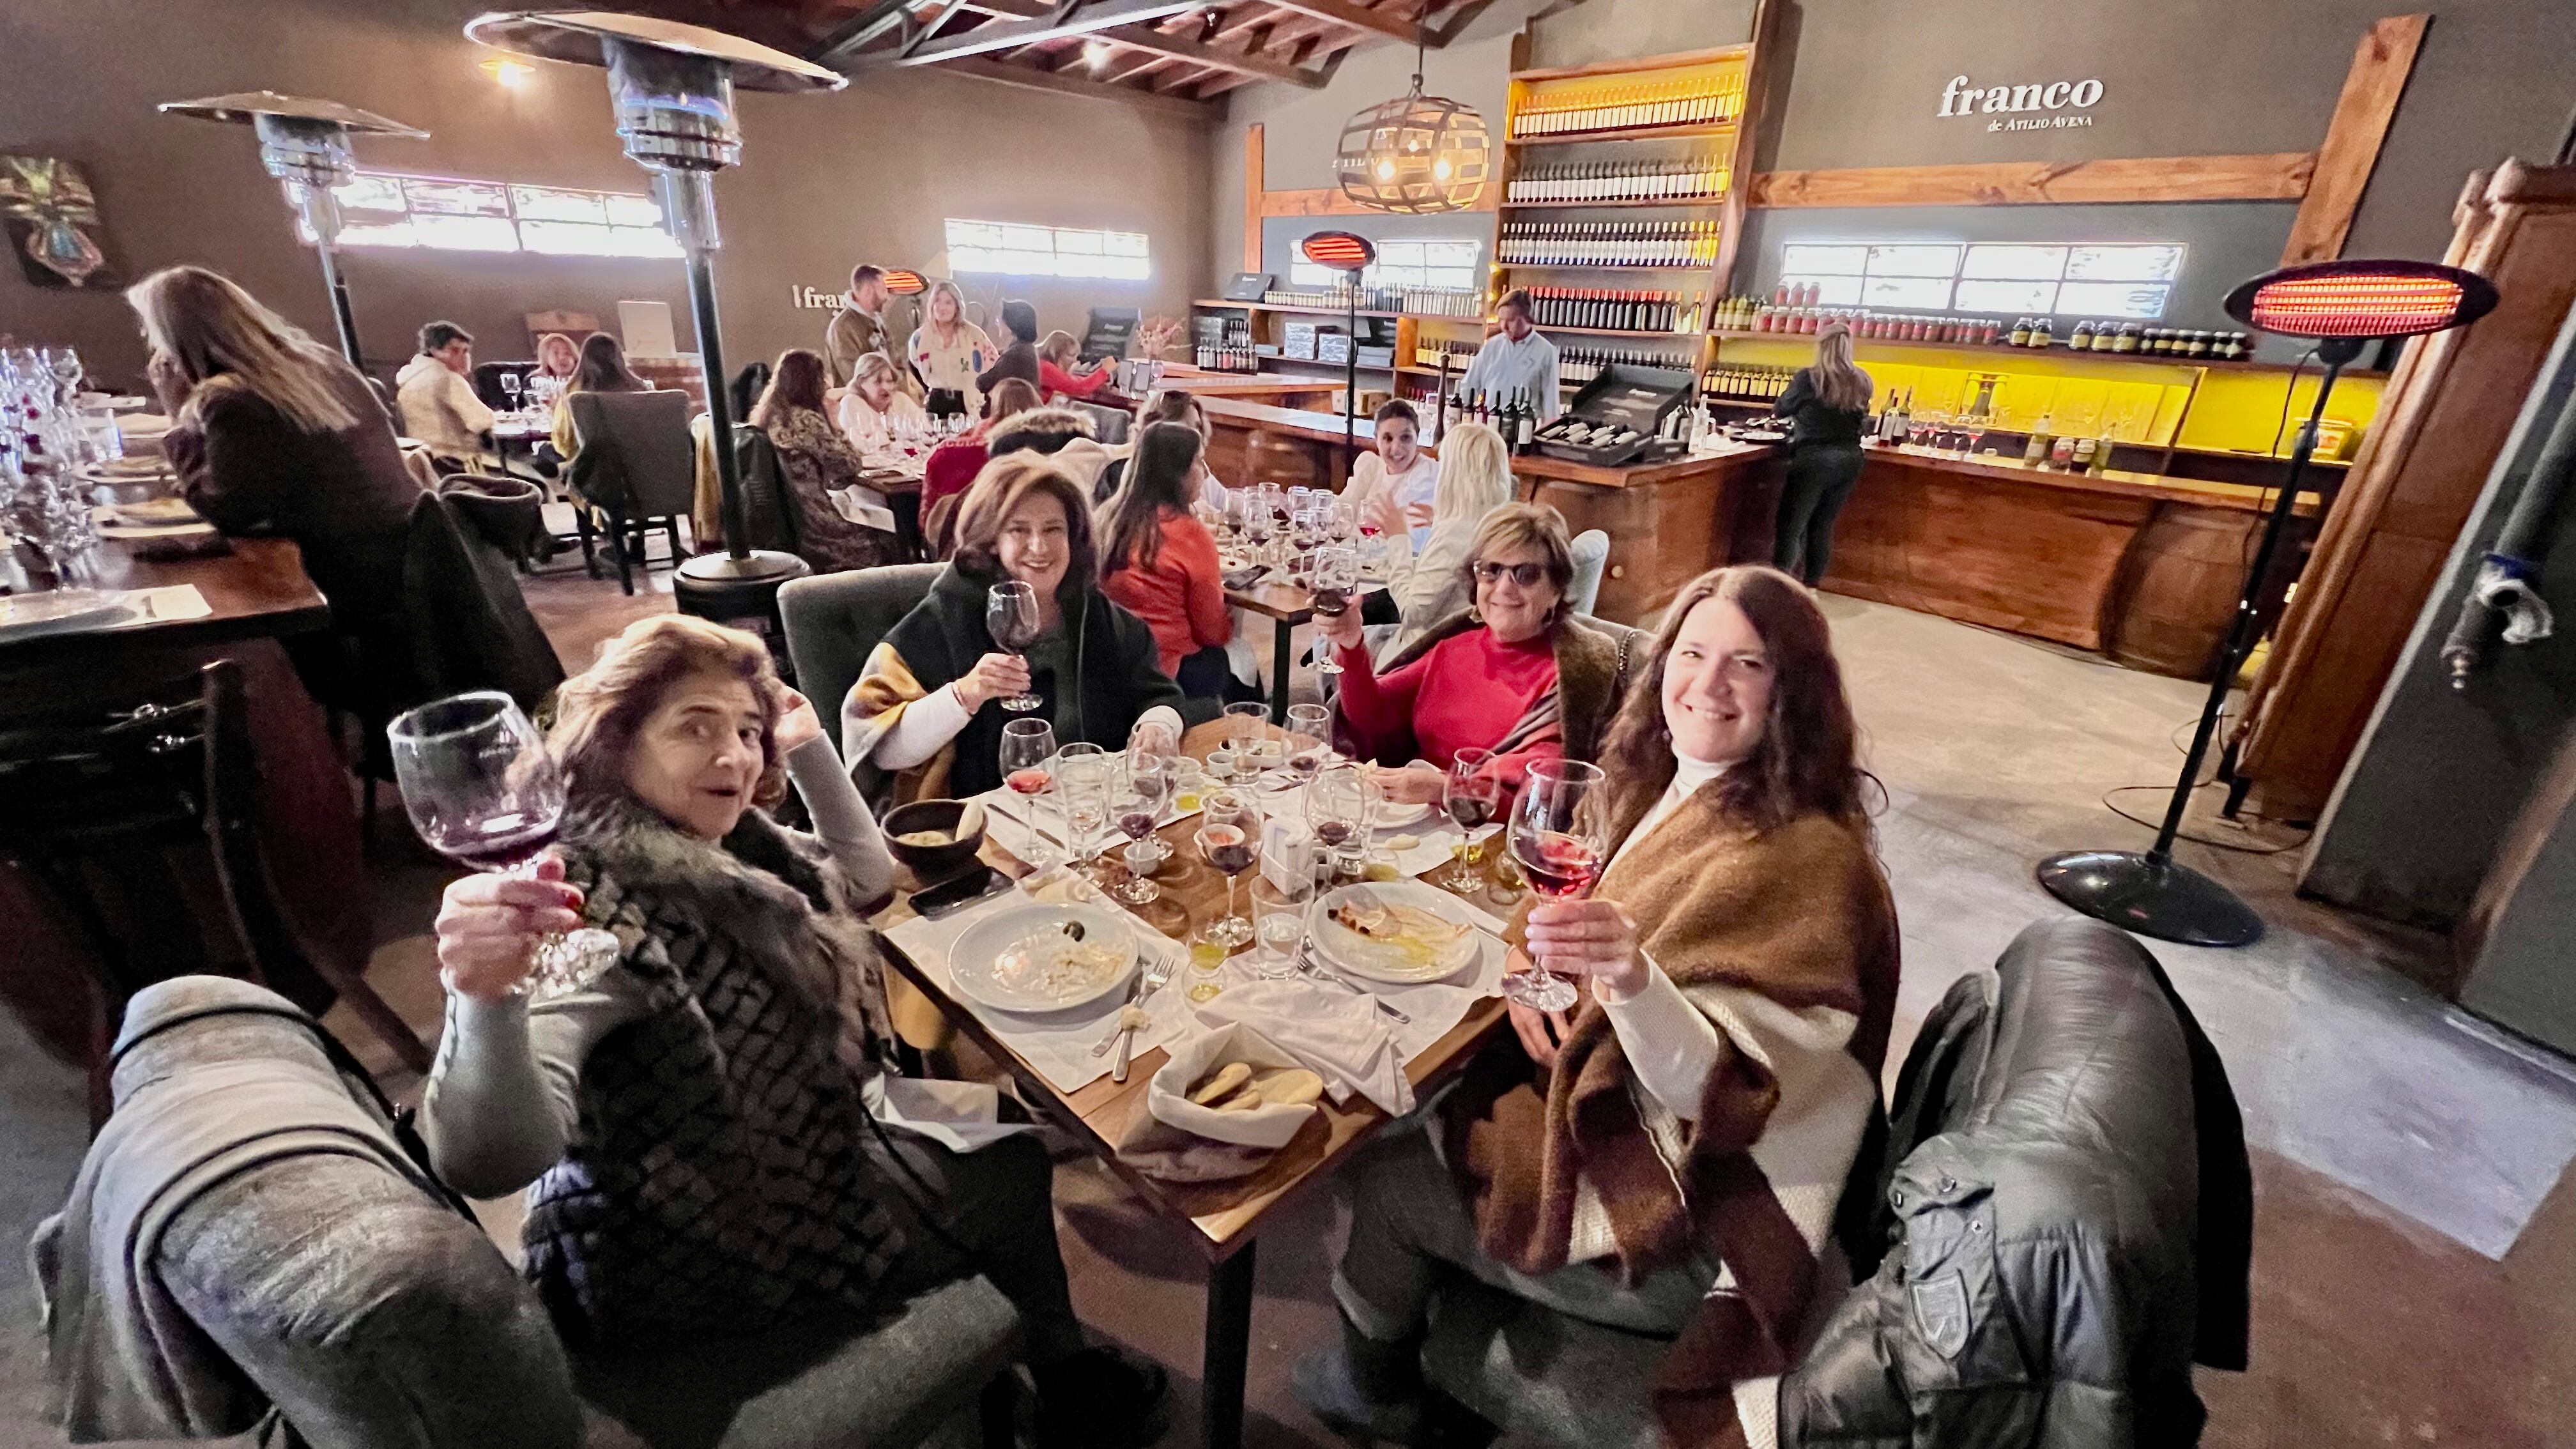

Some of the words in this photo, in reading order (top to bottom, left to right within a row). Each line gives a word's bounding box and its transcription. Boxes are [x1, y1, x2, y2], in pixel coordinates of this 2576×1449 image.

[1936, 75, 2103, 117] franco
[1987, 119, 2002, 132] de
[2004, 118, 2050, 131] ATILIO
[2050, 116, 2092, 128] AVENA
